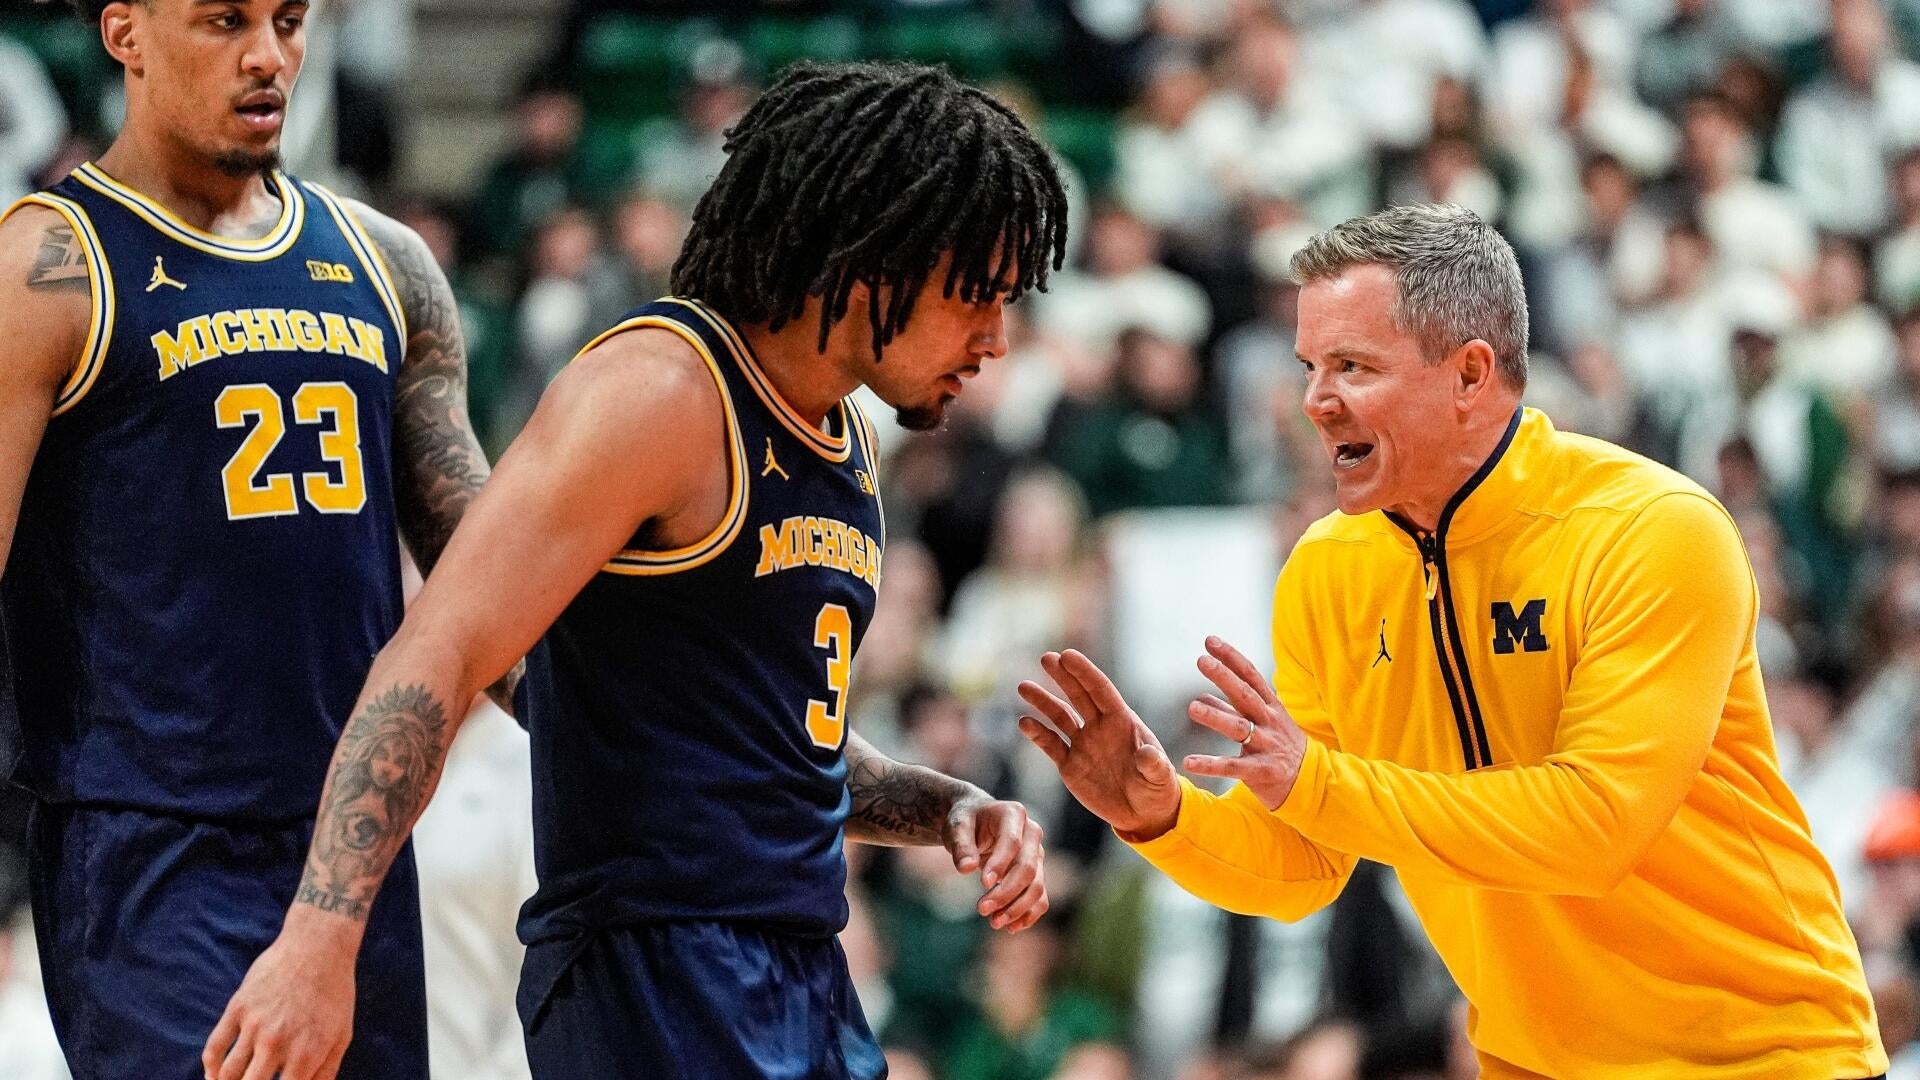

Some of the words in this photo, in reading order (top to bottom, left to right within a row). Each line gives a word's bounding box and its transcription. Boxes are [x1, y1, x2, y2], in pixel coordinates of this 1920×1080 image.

[151, 307, 389, 381] MICHIGAN
[214, 381, 367, 520] 23
[805, 602, 852, 751] 3
[1490, 599, 1549, 655] M
